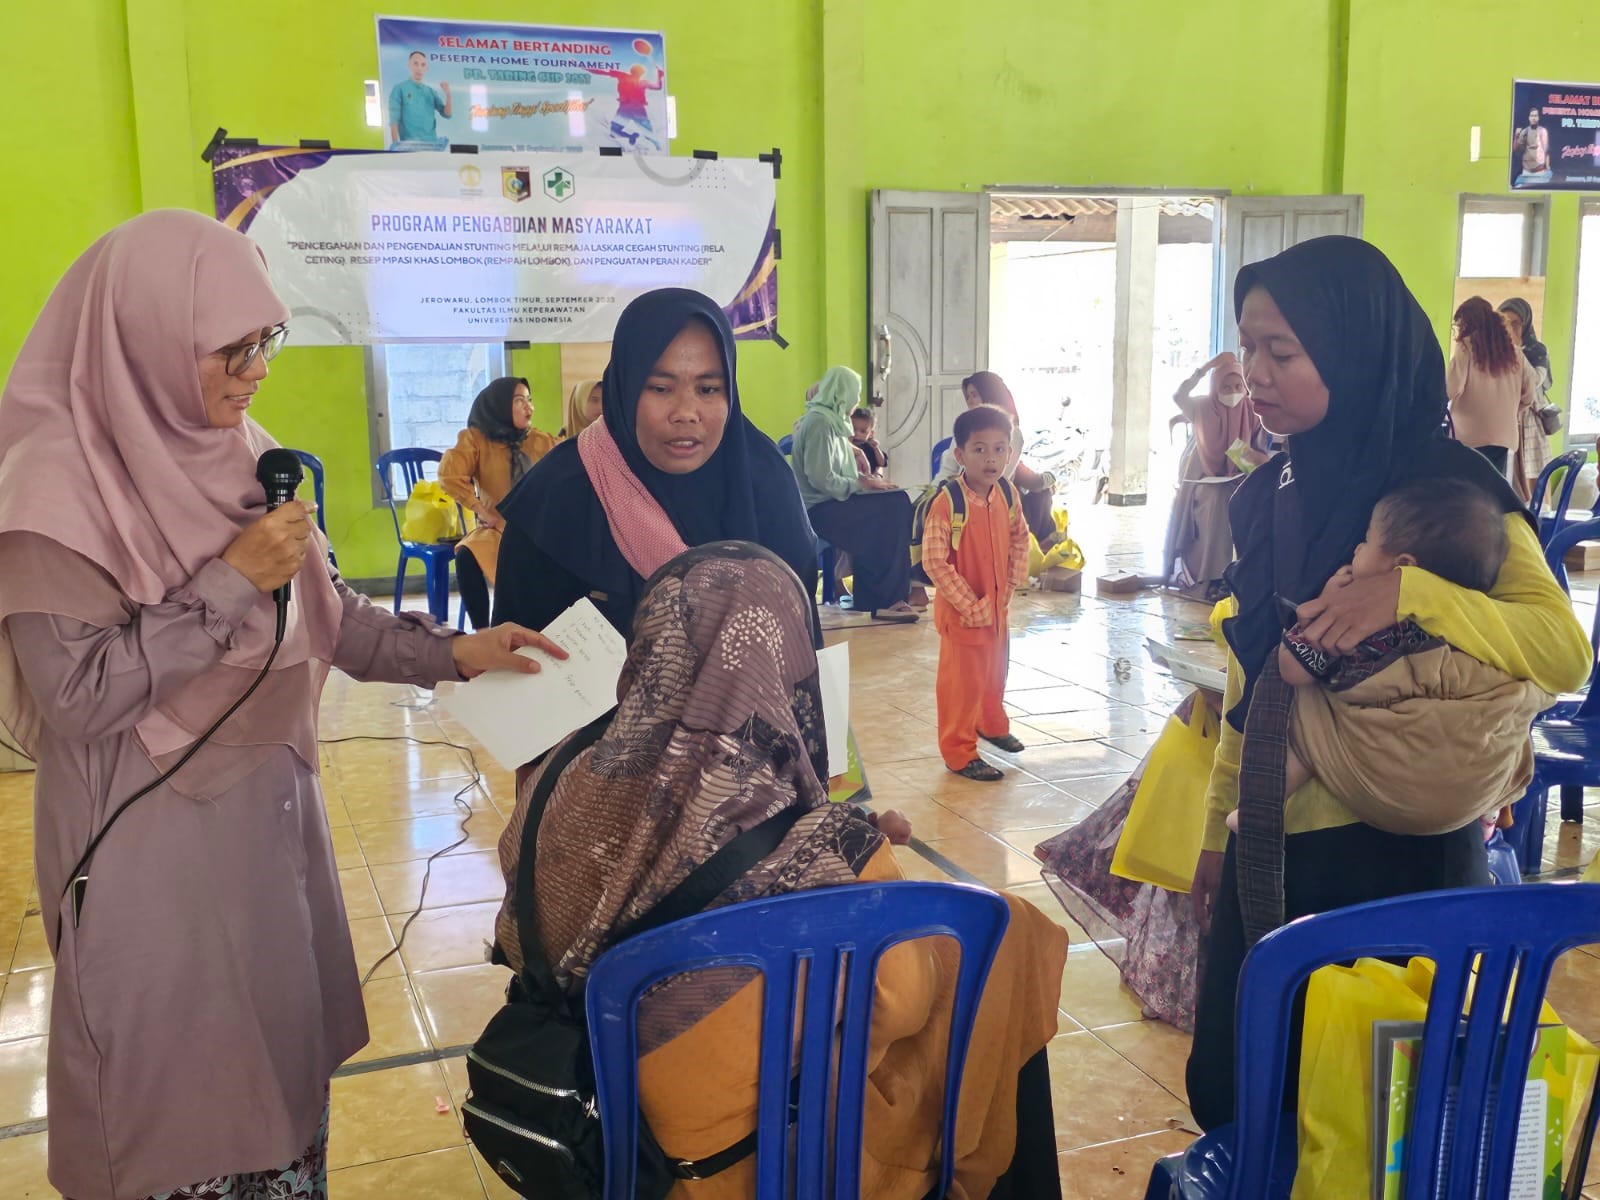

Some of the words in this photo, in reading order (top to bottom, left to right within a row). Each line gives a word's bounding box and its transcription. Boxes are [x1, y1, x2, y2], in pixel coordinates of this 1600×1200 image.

[438, 35, 509, 50] SELAMAT
[513, 40, 612, 55] BERTANDING
[430, 53, 487, 64] PESERTA
[490, 56, 529, 66] HOME
[534, 58, 621, 70] TOURNAMENT
[371, 214, 447, 233] PROGRAM
[452, 215, 548, 233] PENGABDIAN
[552, 217, 653, 234] MASYARAKAT
[364, 242, 385, 250] DAN
[387, 242, 463, 251] PENGENDALIAN
[464, 243, 511, 251] STUNTING
[512, 244, 553, 252] MELALUI
[553, 244, 590, 252] REMAJA
[590, 244, 624, 252] LASKAR
[625, 244, 656, 252] CEGAH
[657, 244, 700, 252] STUNTING
[701, 244, 725, 253] (RELA
[350, 256, 380, 264] RESEP
[382, 256, 412, 264] MPASI
[414, 256, 440, 264] KHAS
[441, 256, 483, 265] LOMBOK
[484, 257, 527, 266] (REMPAH
[594, 257, 649, 265] PENGUATAN
[522, 306, 586, 314] KEPERAWATAN
[526, 316, 572, 324] INDONESIA
